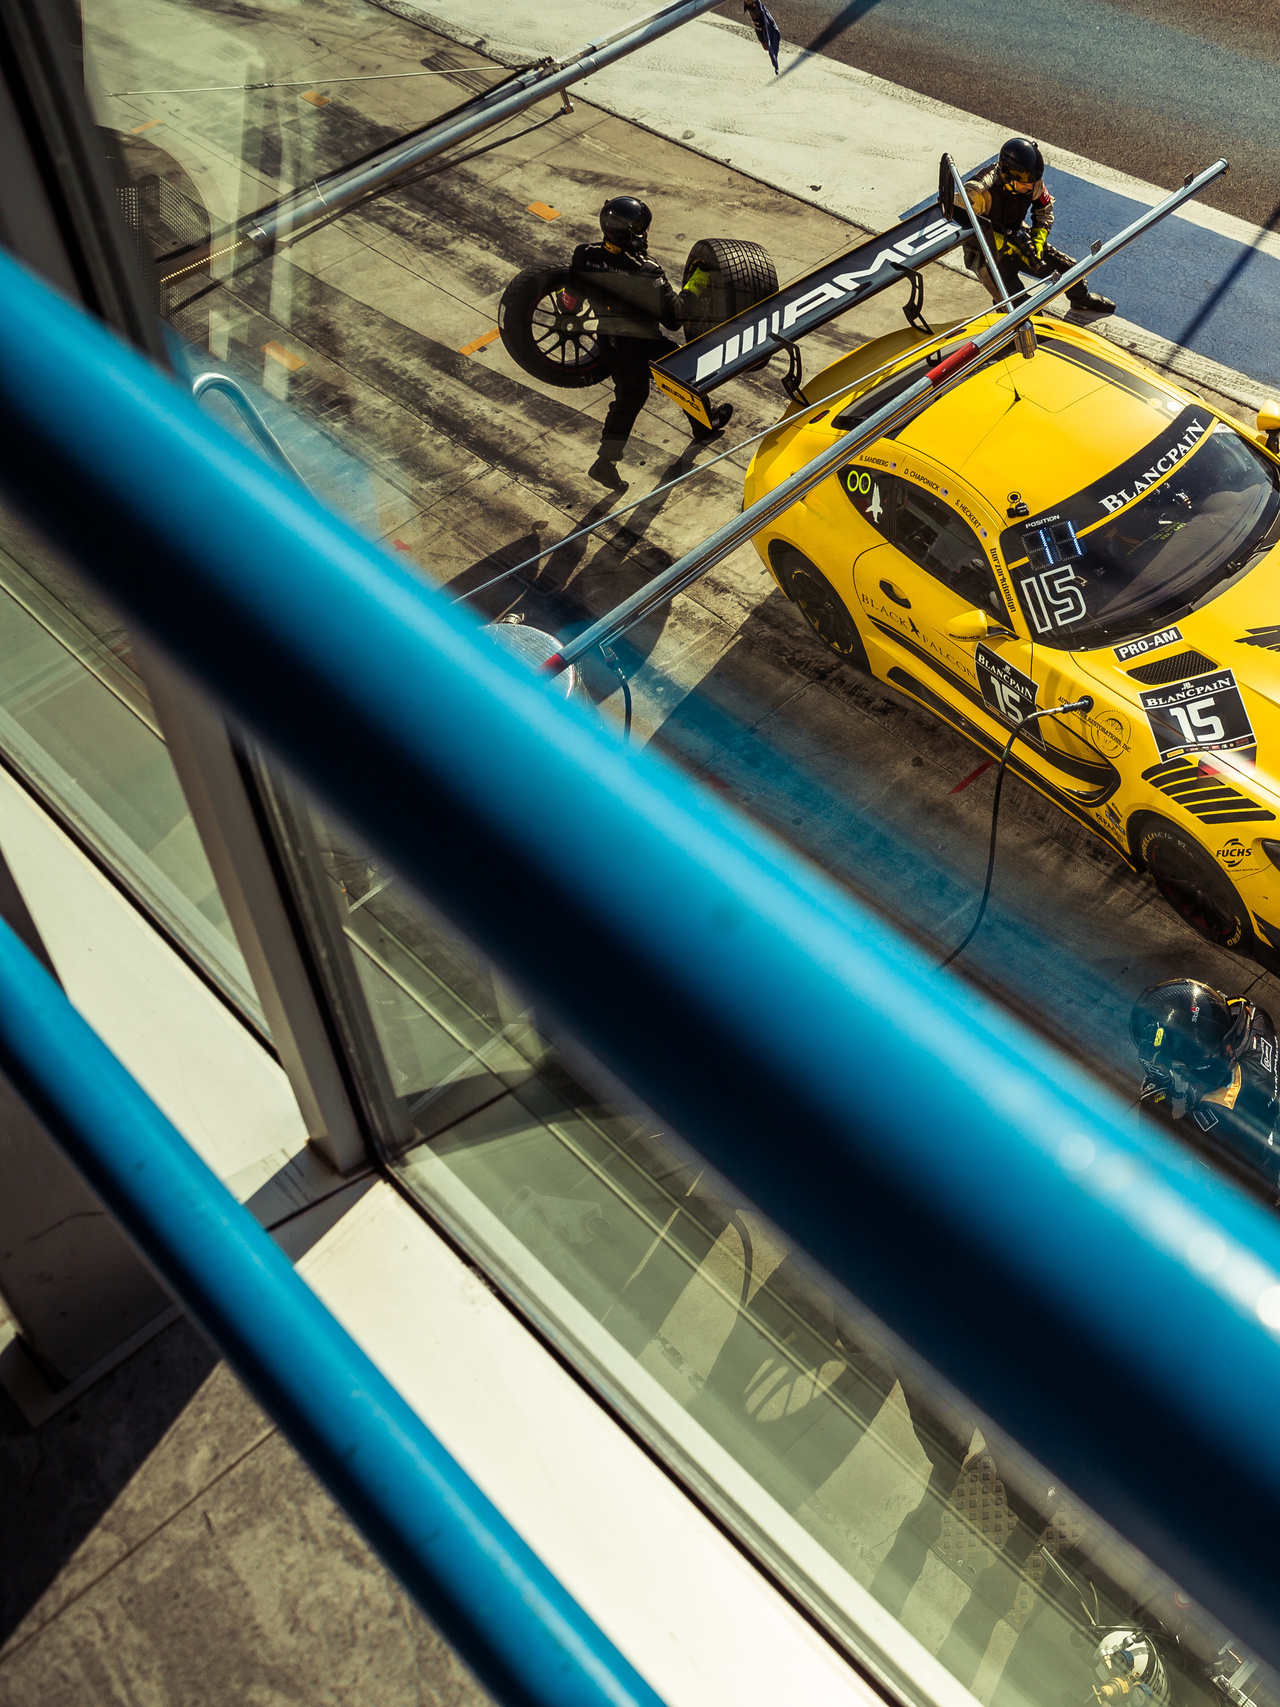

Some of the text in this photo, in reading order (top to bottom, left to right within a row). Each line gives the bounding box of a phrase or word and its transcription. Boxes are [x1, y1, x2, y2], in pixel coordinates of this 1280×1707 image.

[864, 455, 889, 468] SANDBERG
[1098, 418, 1206, 514] BLANCPAIN
[909, 470, 941, 492] CHAPONICK
[959, 503, 982, 529] HECKERT
[1025, 514, 1060, 529] POSITION
[1020, 564, 1087, 634] 15
[861, 593, 977, 681] BLACK FALCON
[1119, 629, 1178, 659] PRO-AM
[978, 653, 1033, 700] BLANCPAIN
[990, 675, 1024, 725] 15
[1145, 677, 1231, 707] BLANCPAIN
[1168, 697, 1225, 744] 15
[1216, 848, 1252, 858] FUCHS
